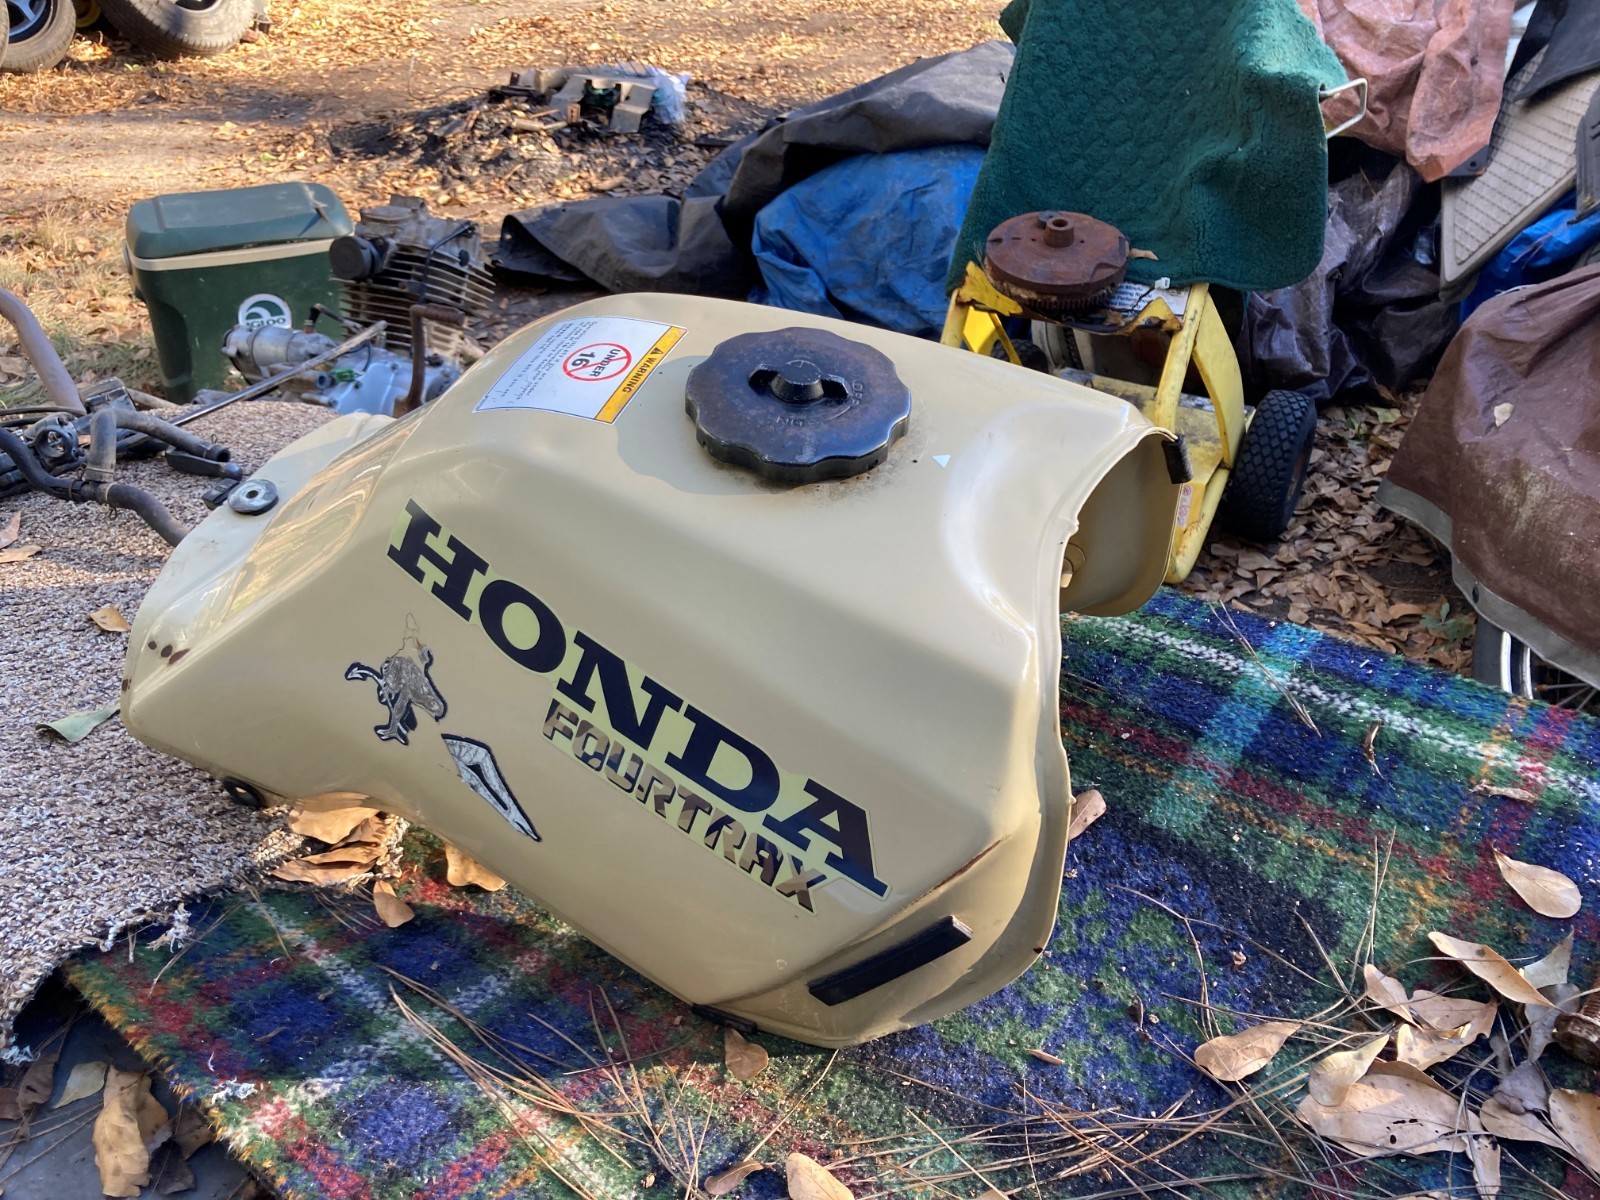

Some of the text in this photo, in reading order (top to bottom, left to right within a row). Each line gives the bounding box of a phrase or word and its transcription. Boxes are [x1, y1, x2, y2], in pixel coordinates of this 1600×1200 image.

[571, 351, 596, 368] 16
[589, 348, 621, 378] UNDER
[622, 357, 657, 393] WARNING
[387, 499, 888, 897] HONDA
[543, 697, 827, 913] FOURTRAX
